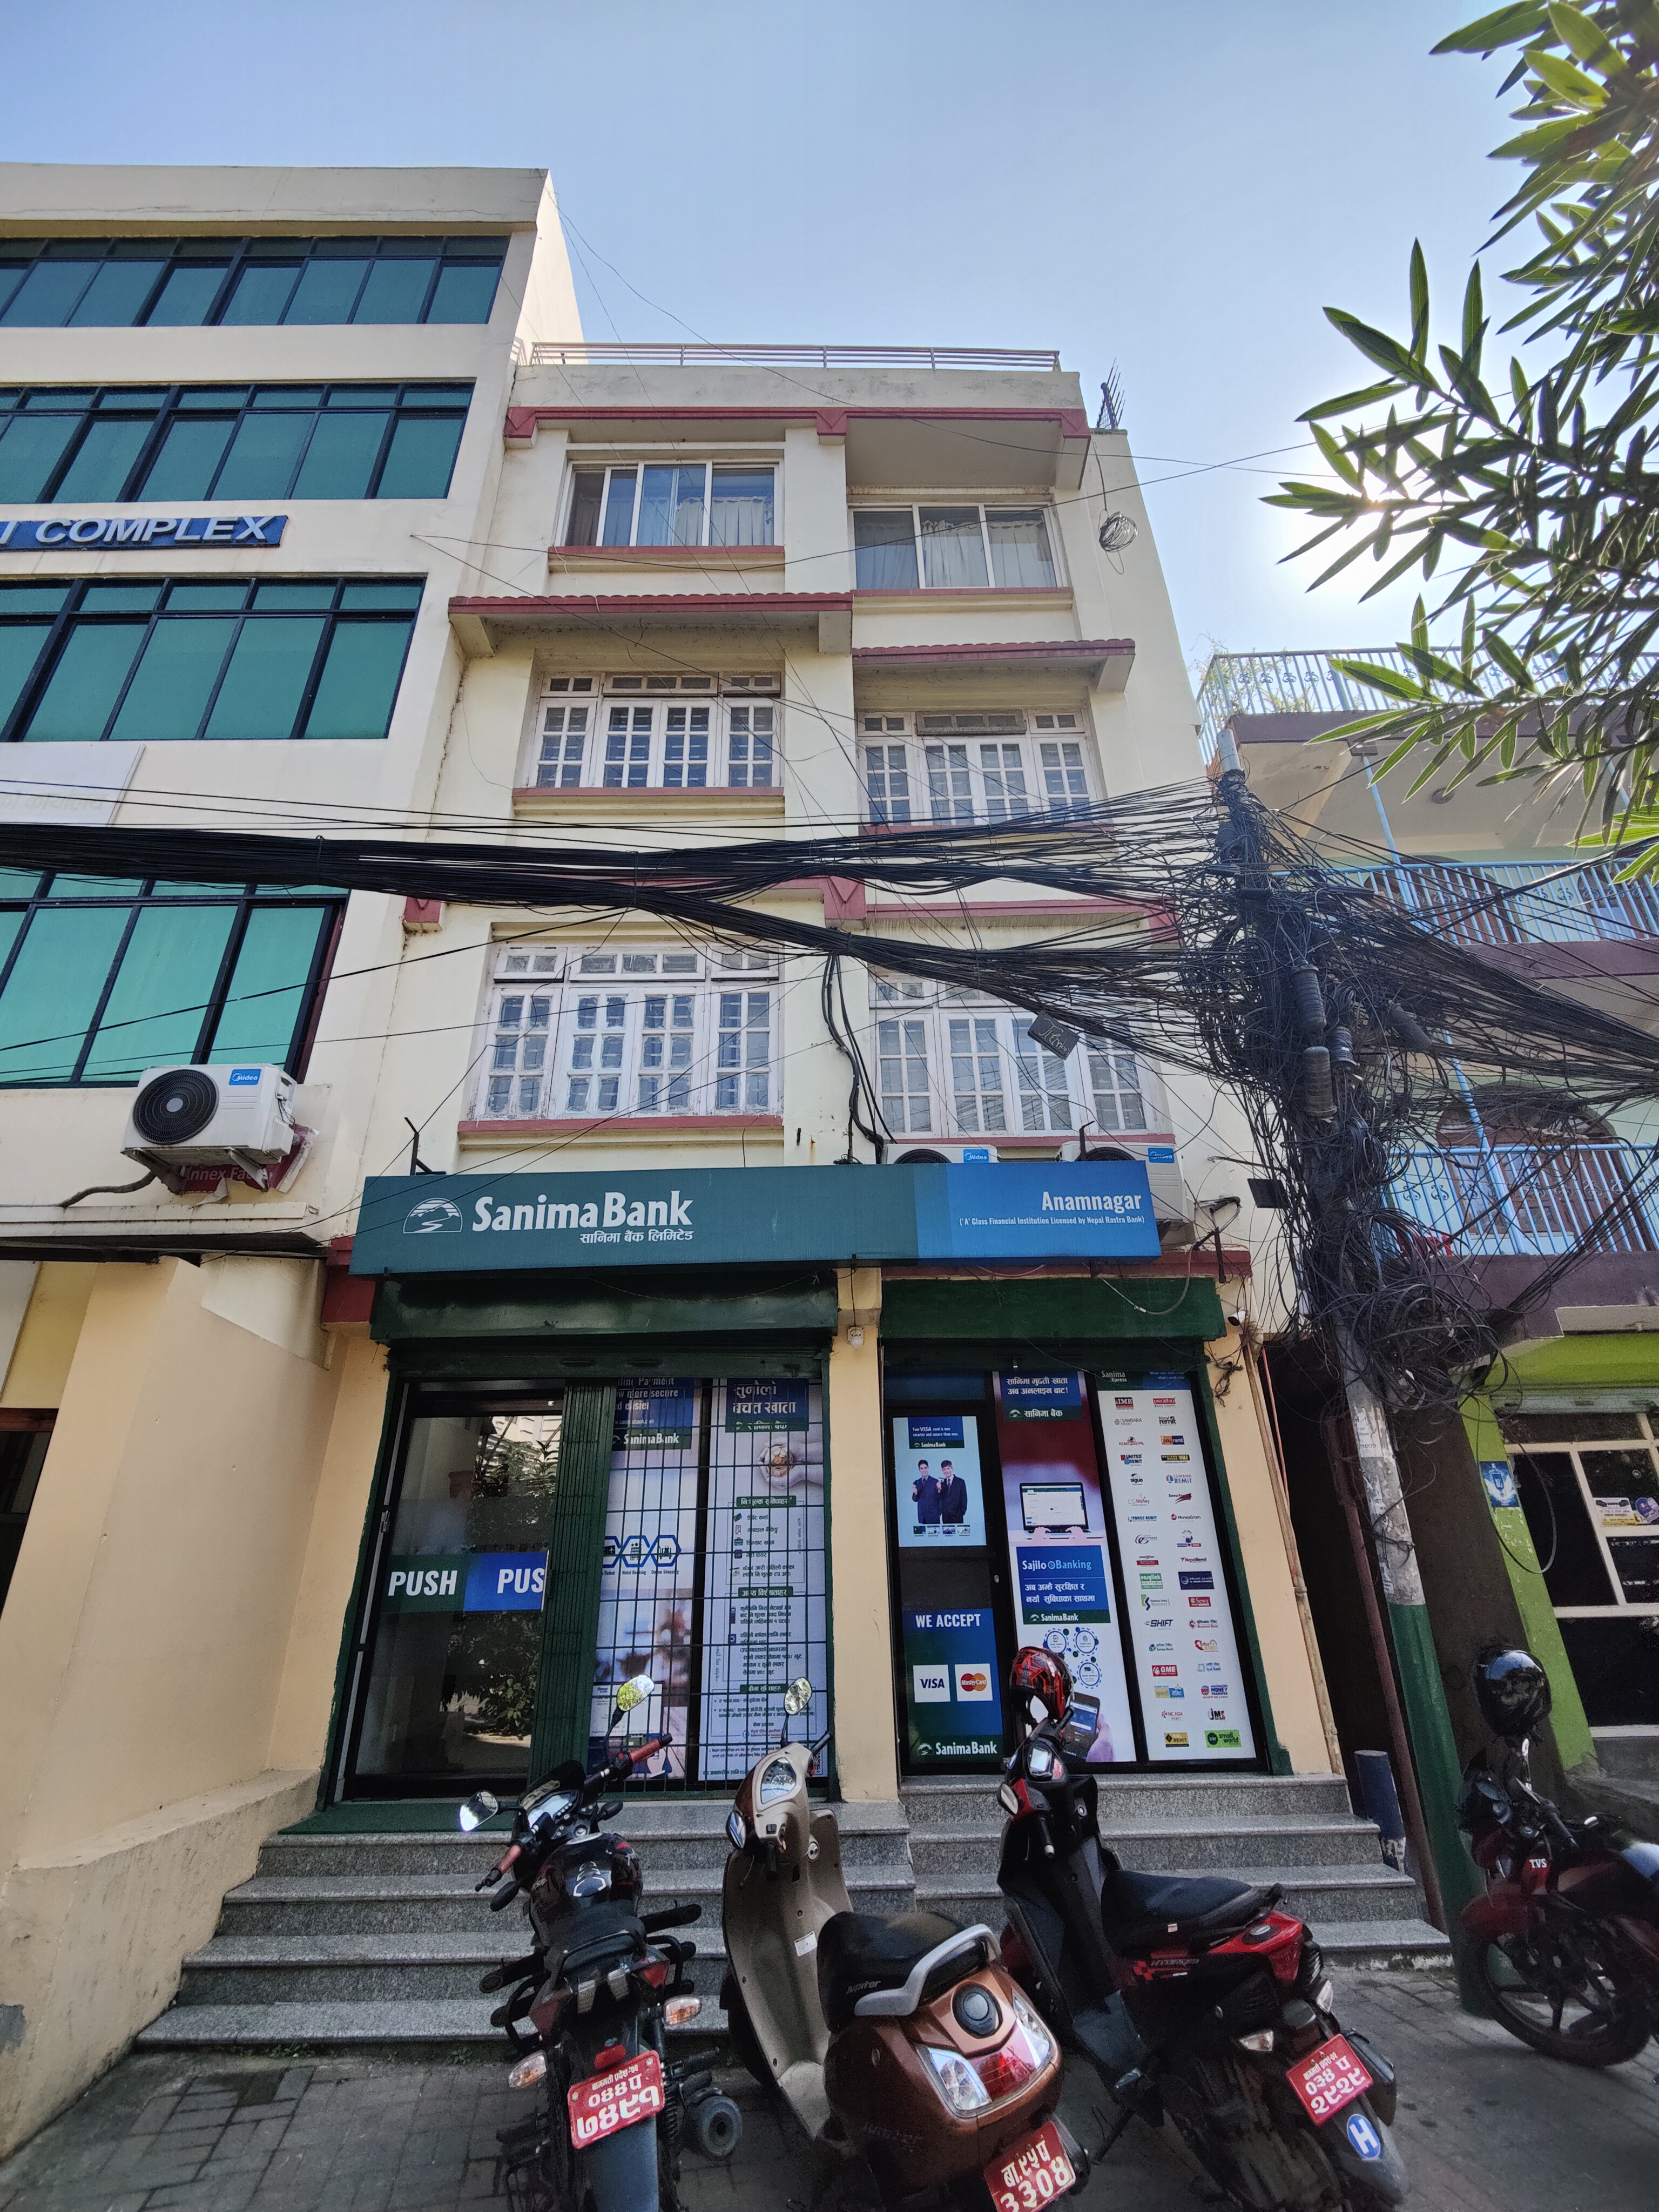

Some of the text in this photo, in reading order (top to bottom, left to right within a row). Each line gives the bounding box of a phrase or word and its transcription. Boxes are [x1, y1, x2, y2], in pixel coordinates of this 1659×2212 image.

[36, 516, 275, 543] COMPLEX
[232, 1073, 258, 1081] Midea
[965, 1151, 988, 1161] Midea
[186, 1169, 227, 1181] nnex
[1042, 1191, 1142, 1213] Anamnagar
[989, 1217, 1016, 1225] Financial
[1017, 1217, 1049, 1225] Institution
[1051, 1217, 1077, 1225] Licensed
[1078, 1217, 1085, 1226] by
[1087, 1216, 1104, 1226] Nepal
[1127, 1215, 1145, 1224] Bank)
[579, 1228, 693, 1244] सानिमा बैंक लिमिटेड
[1007, 1377, 1030, 1385] सानिमा
[1024, 1408, 1063, 1418] सानिमा बैंक
[1022, 1560, 1047, 1572] Sajilo
[388, 1570, 457, 1596] PUSH
[915, 1614, 981, 1628] WE ACCEPT
[919, 1678, 945, 1688] VISA
[1529, 1858, 1547, 1869] TVS
[1349, 2117, 1378, 2154] H
